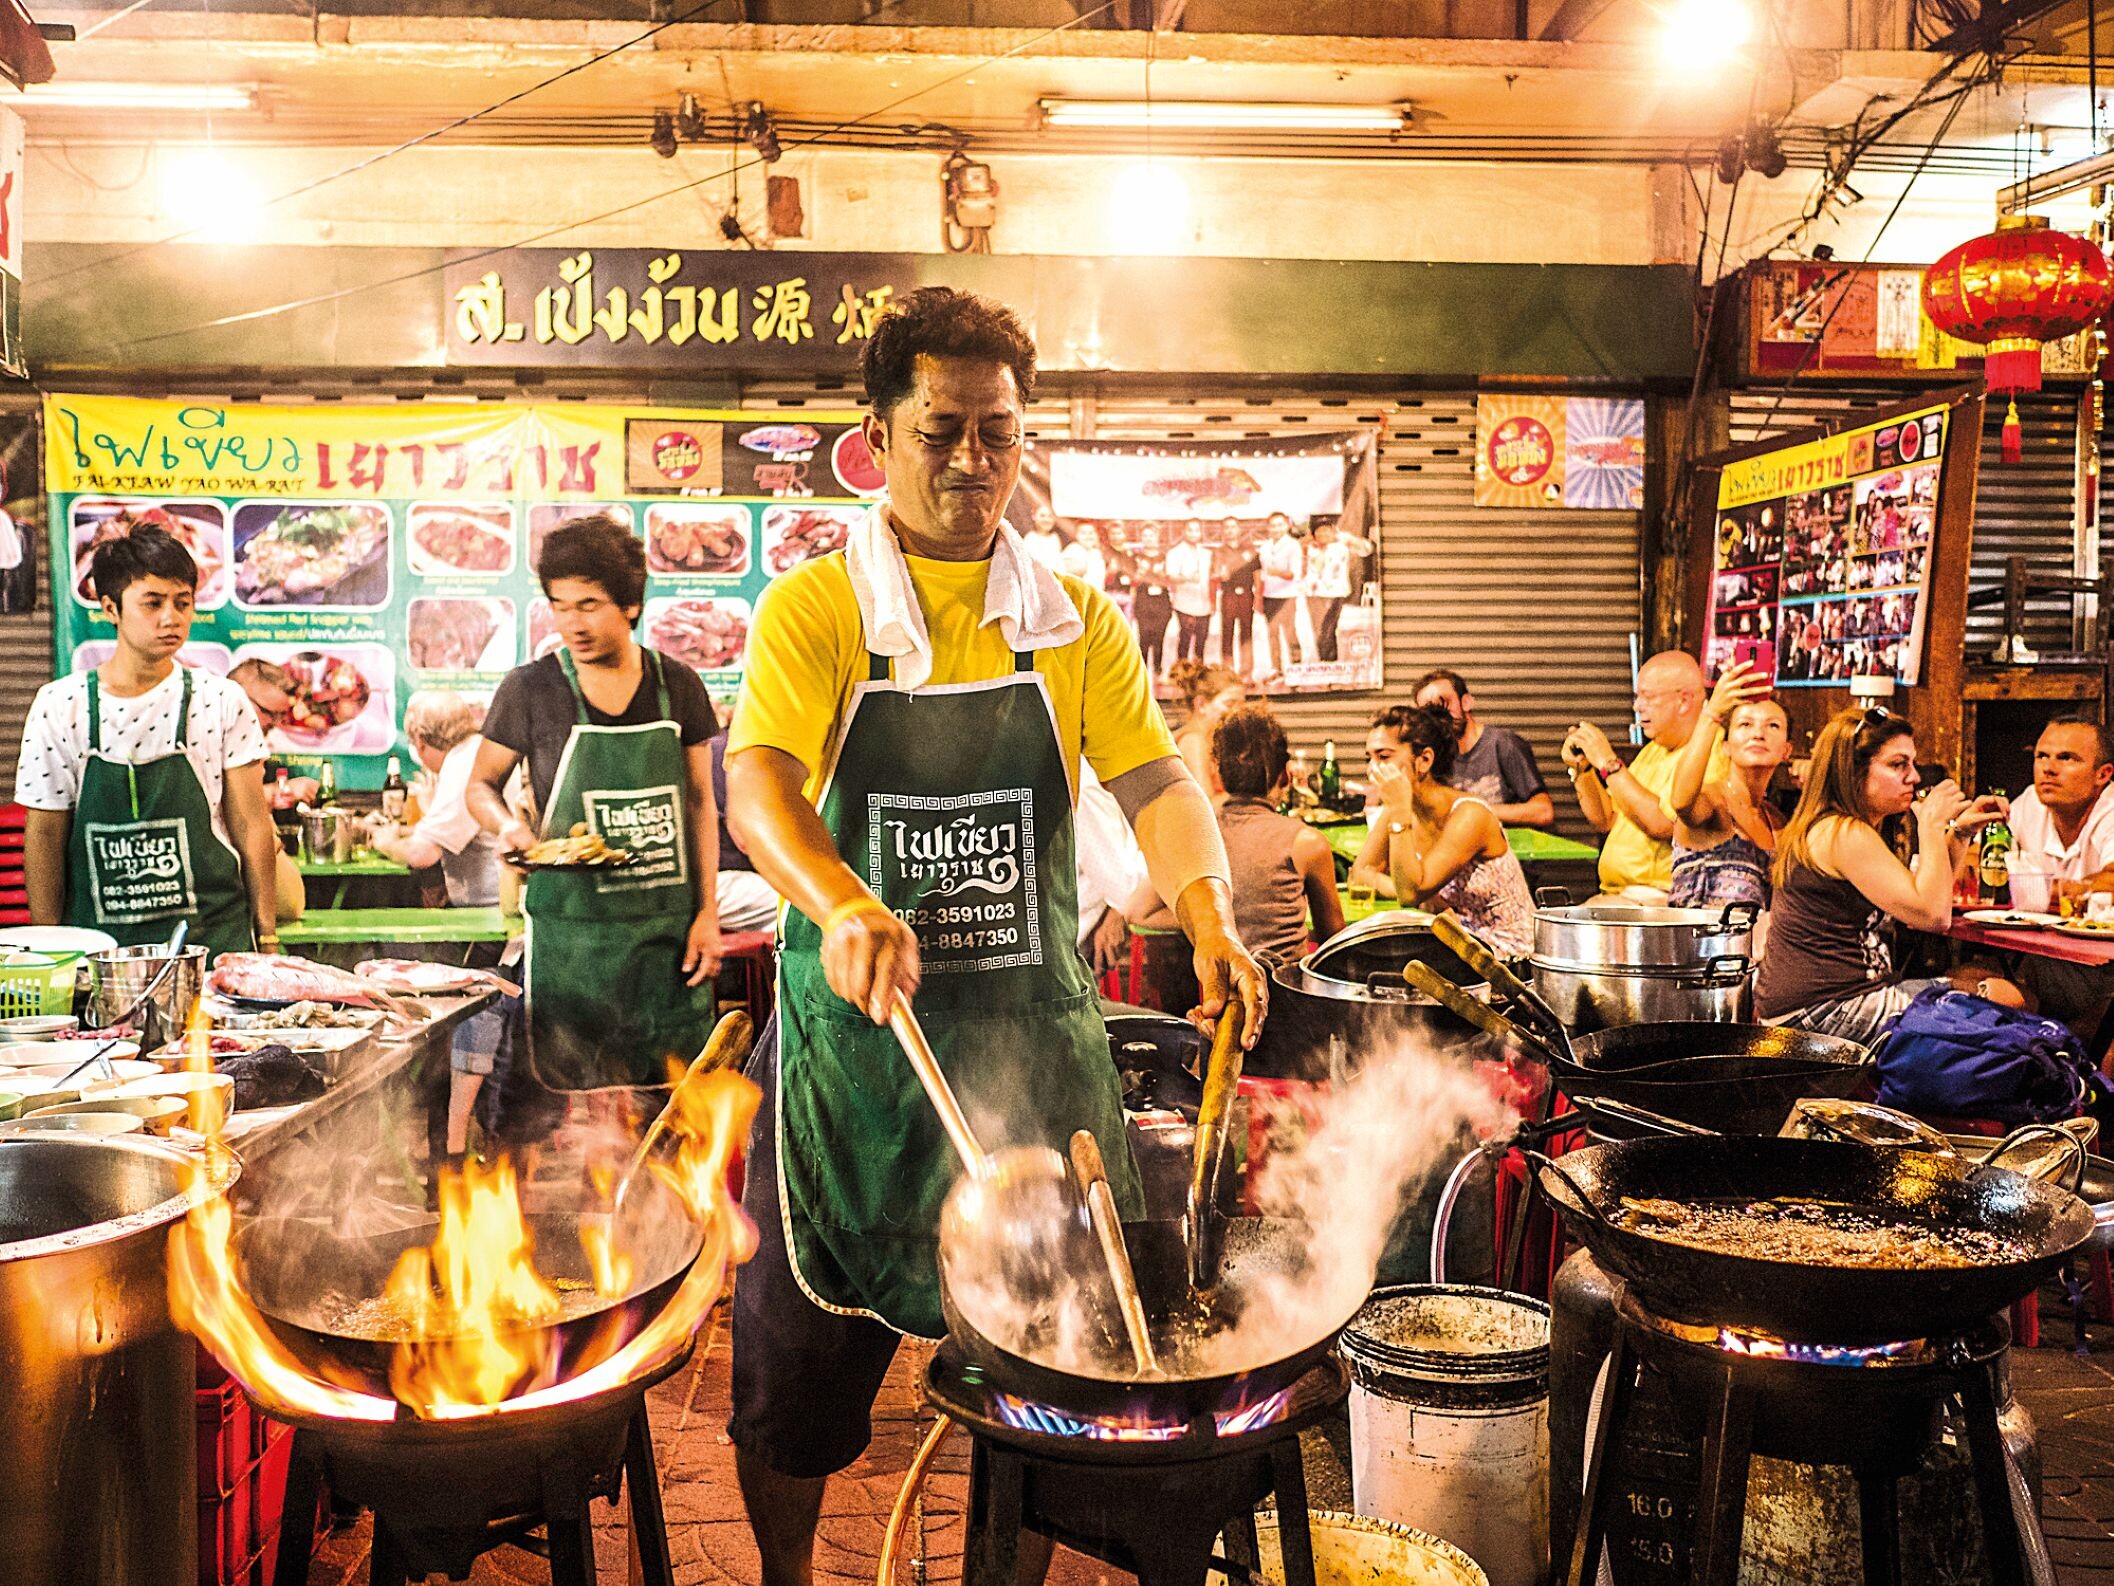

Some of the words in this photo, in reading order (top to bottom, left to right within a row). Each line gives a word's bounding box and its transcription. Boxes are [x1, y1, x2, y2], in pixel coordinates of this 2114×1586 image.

[60, 407, 303, 472] ไฟเขียว
[94, 832, 176, 859] ไฟเขียว
[883, 813, 1016, 860] ไฟเขียว
[901, 858, 984, 880] เยาวราช
[919, 927, 1018, 951] 4-8847350
